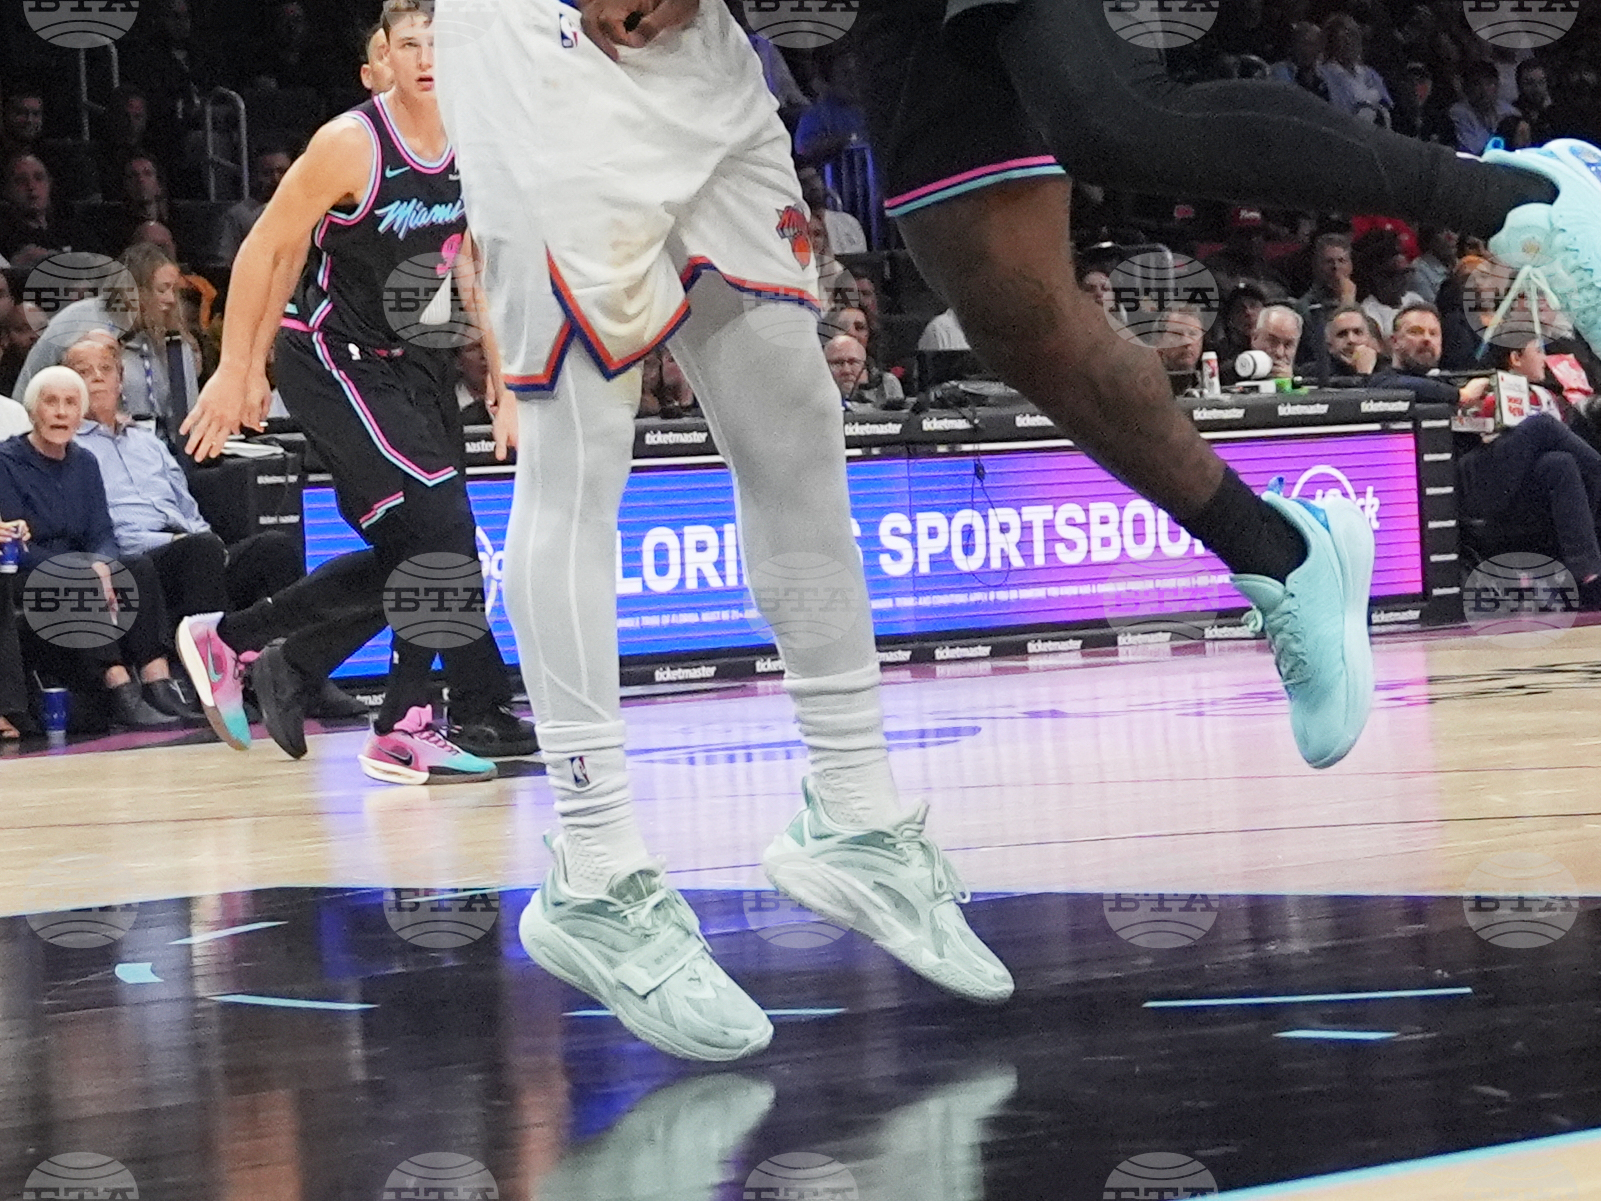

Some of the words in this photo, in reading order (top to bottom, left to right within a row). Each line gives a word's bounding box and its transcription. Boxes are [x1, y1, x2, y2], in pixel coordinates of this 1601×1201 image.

[645, 430, 708, 445] ticketmaster
[878, 498, 1205, 576] SPORTSBOO
[654, 665, 717, 682] ticketmaster
